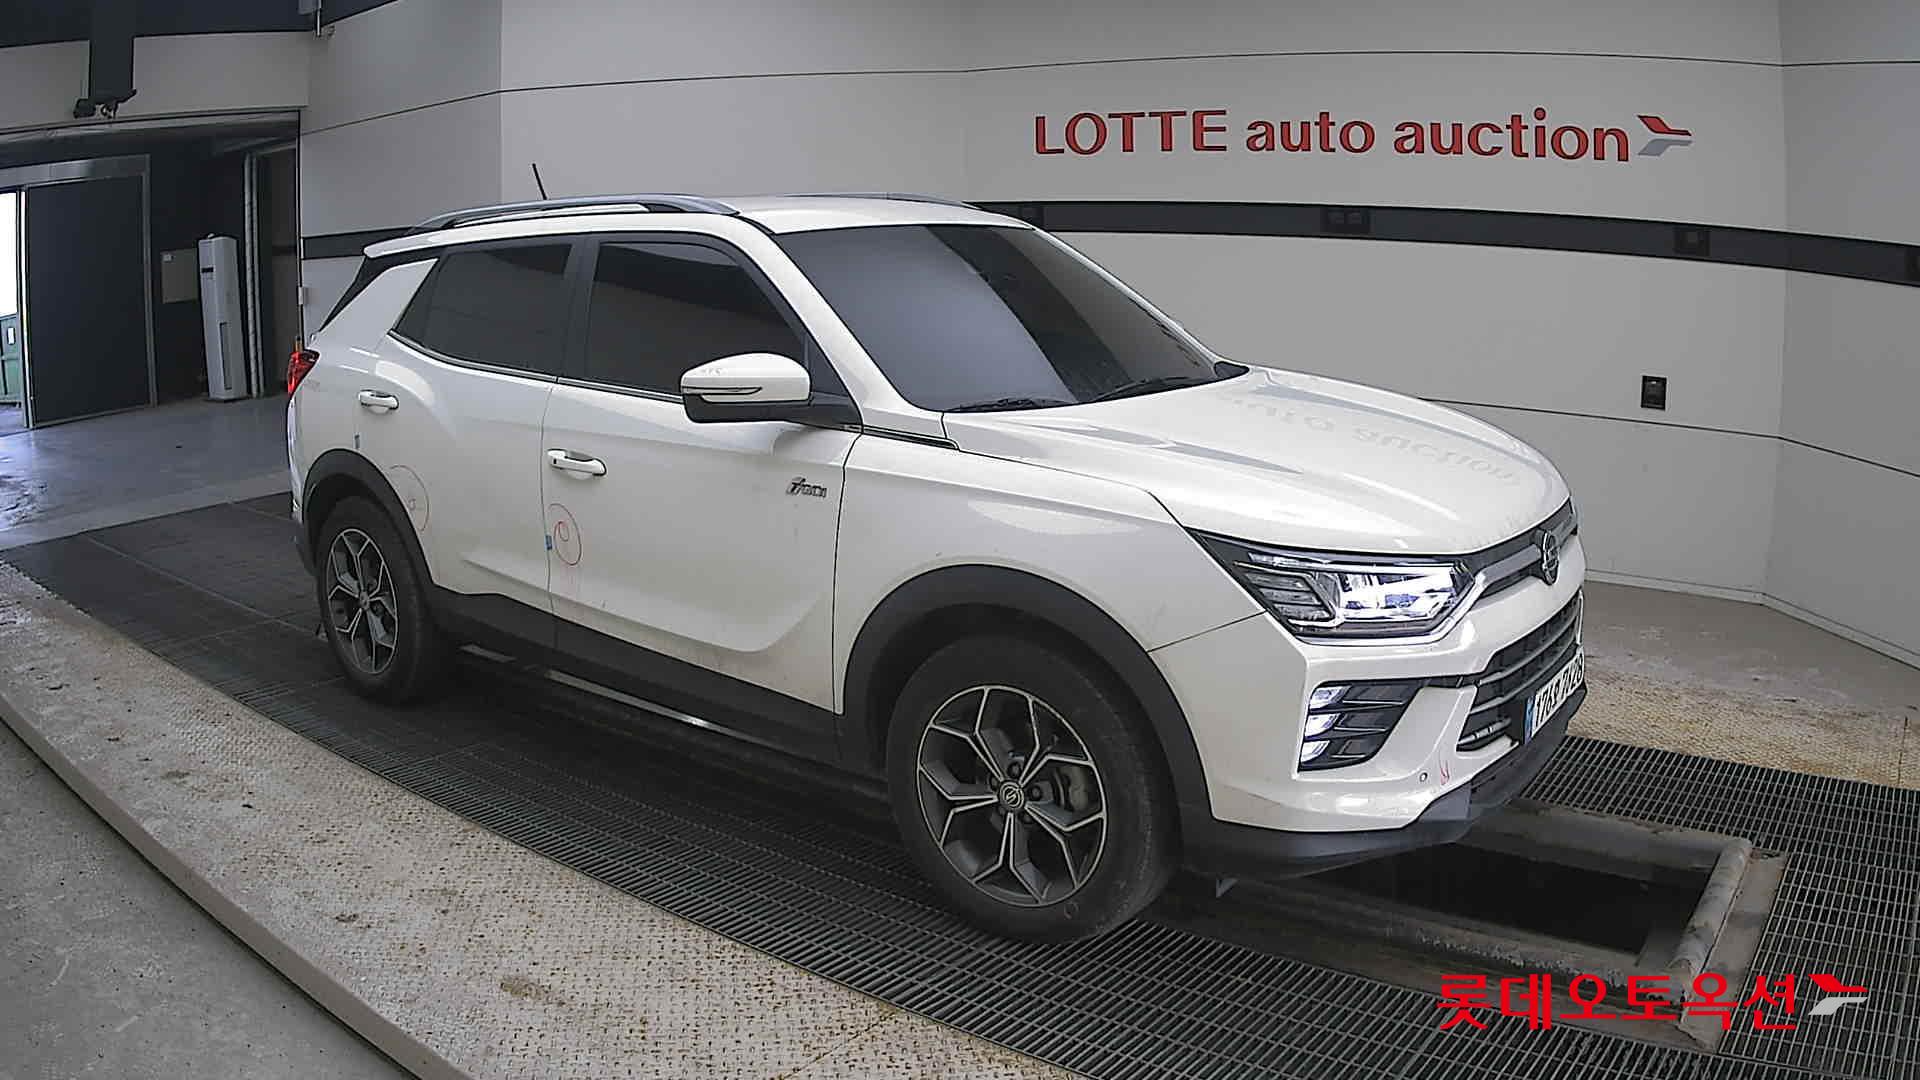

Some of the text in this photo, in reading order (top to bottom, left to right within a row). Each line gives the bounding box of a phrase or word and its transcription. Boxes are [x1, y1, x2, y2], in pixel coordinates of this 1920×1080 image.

[1034, 106, 1631, 163] LOTTE auto auction
